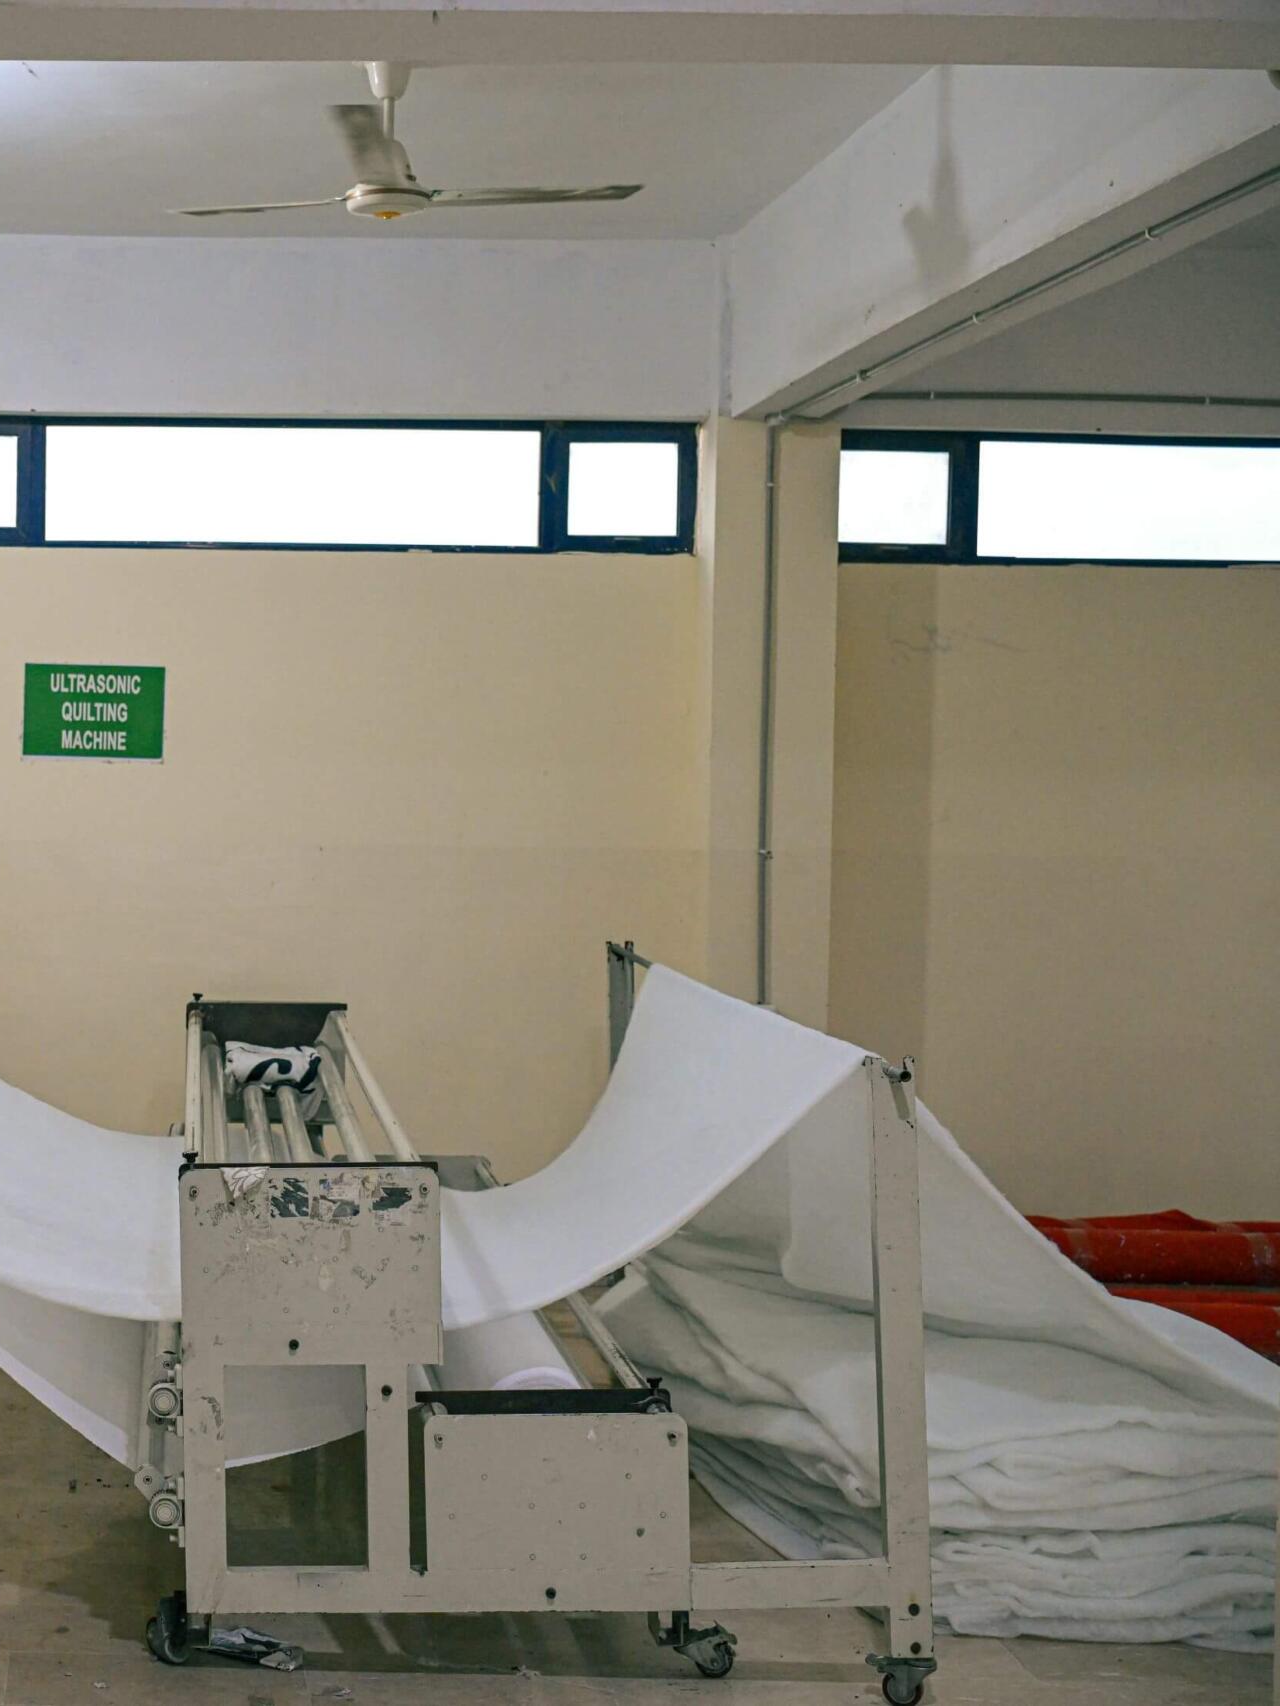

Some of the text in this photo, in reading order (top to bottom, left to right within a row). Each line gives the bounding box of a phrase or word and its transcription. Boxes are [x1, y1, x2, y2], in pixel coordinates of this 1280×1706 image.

[50, 673, 141, 694] ULTRASONIC
[61, 702, 128, 722] QUILTING
[61, 730, 127, 750] MACHINE
